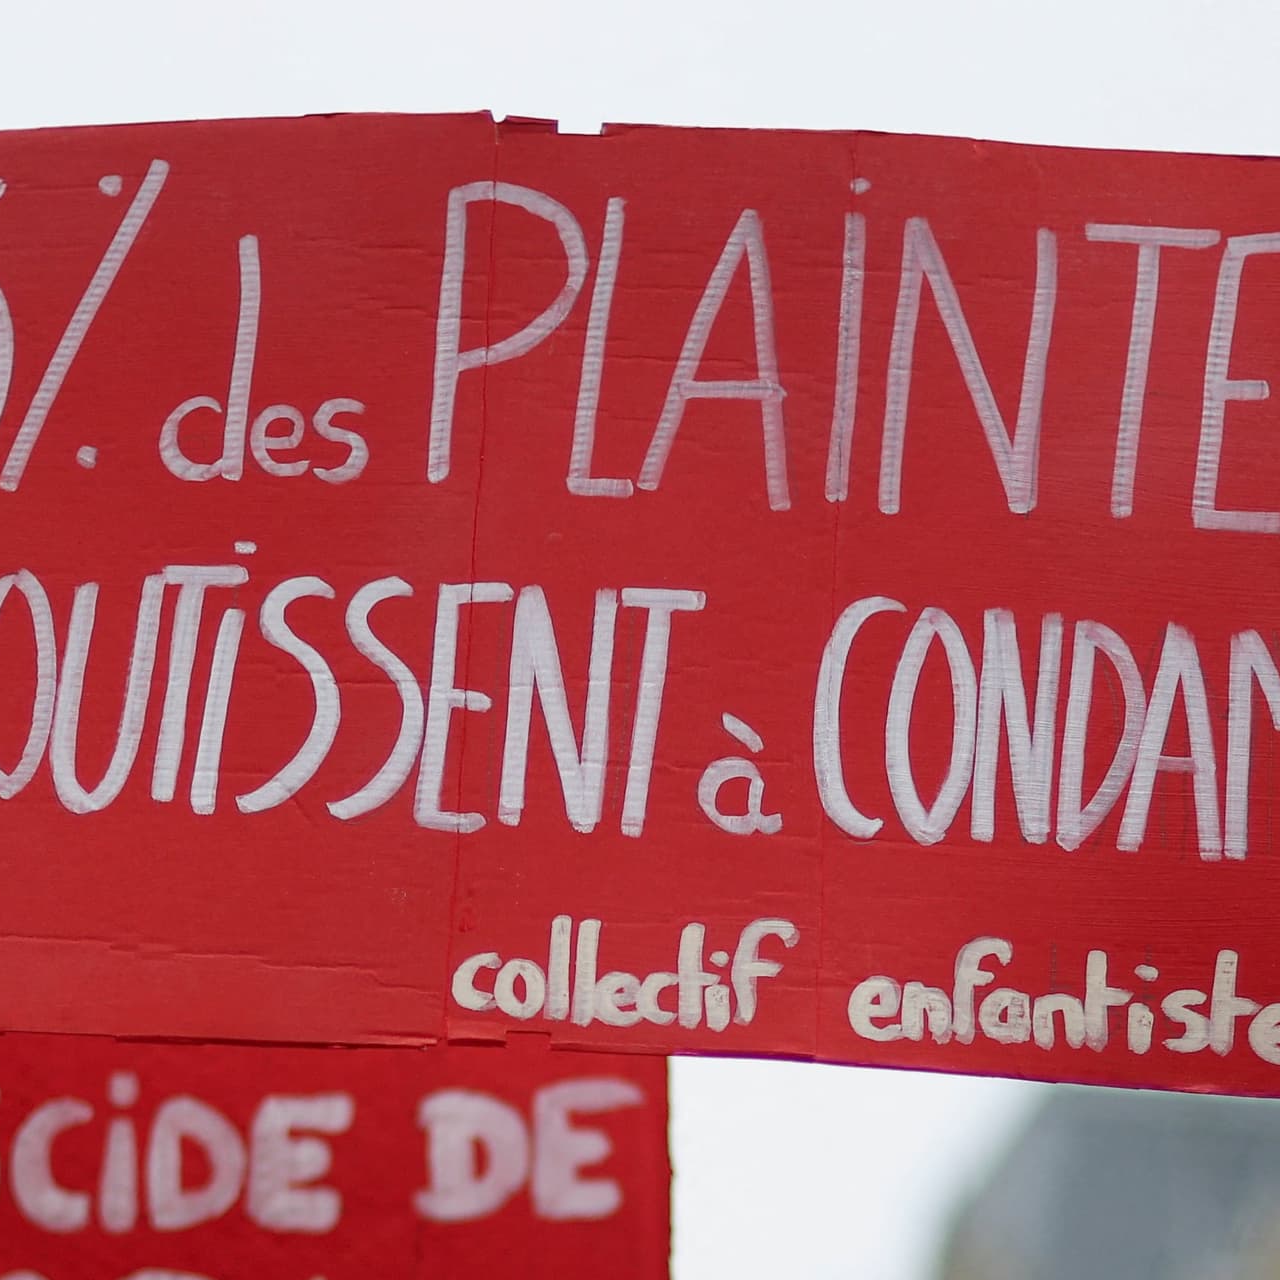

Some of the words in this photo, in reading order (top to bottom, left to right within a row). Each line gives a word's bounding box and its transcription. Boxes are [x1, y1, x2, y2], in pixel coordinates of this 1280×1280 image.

[159, 235, 369, 483] des
[697, 713, 783, 834] à
[451, 914, 799, 1034] collectif
[415, 1077, 645, 1224] DE
